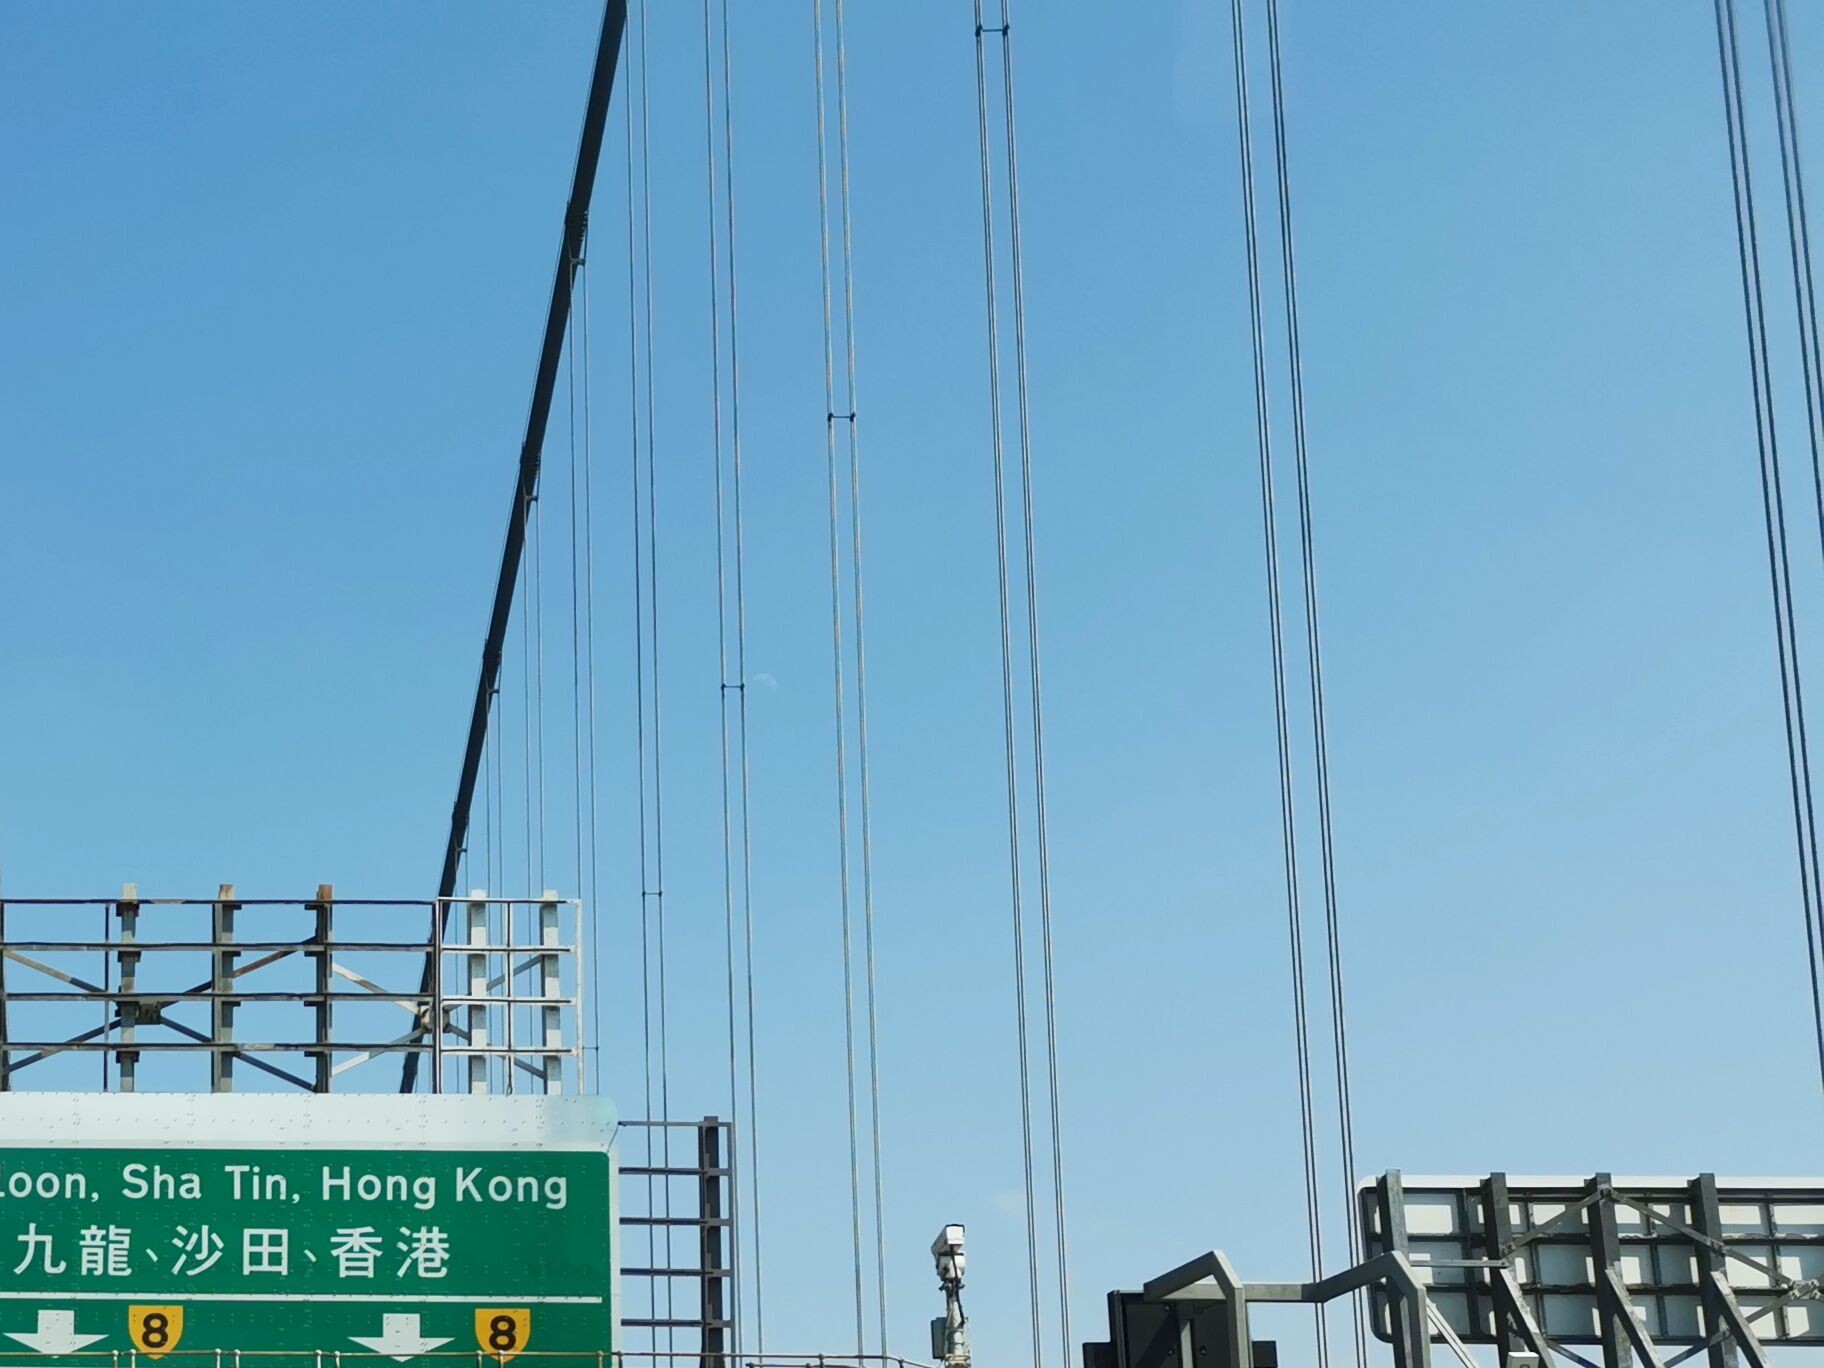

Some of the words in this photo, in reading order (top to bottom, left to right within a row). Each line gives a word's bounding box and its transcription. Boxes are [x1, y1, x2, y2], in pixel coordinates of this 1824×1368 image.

[122, 1163, 202, 1199] Sha
[224, 1165, 301, 1204] Tin,
[322, 1166, 436, 1210] Hong
[455, 1167, 567, 1210] Kong
[13, 1222, 450, 1278] 九龍、沙田、香港
[141, 1312, 169, 1349] 8
[488, 1313, 517, 1351] 8
